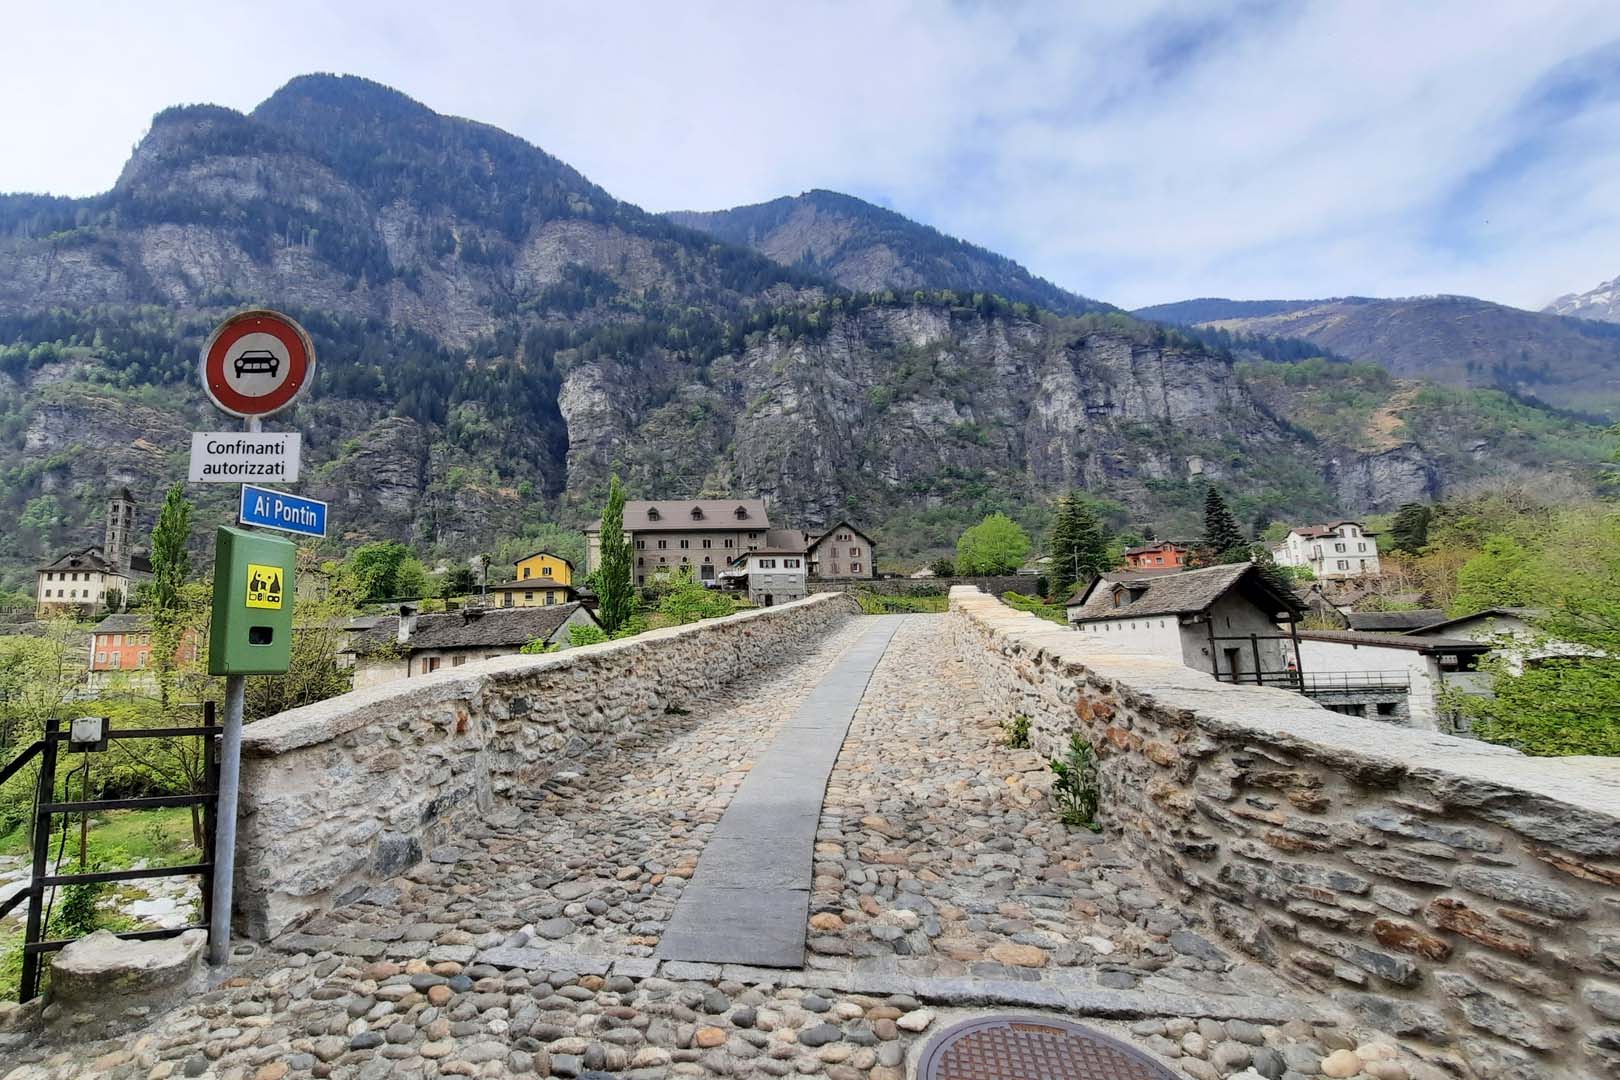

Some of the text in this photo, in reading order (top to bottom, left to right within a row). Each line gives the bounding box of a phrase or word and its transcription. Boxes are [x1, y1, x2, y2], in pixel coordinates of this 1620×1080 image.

[207, 440, 285, 454] Confinanti
[203, 461, 285, 475] autorizzati
[254, 495, 317, 527] Ai Pontin
